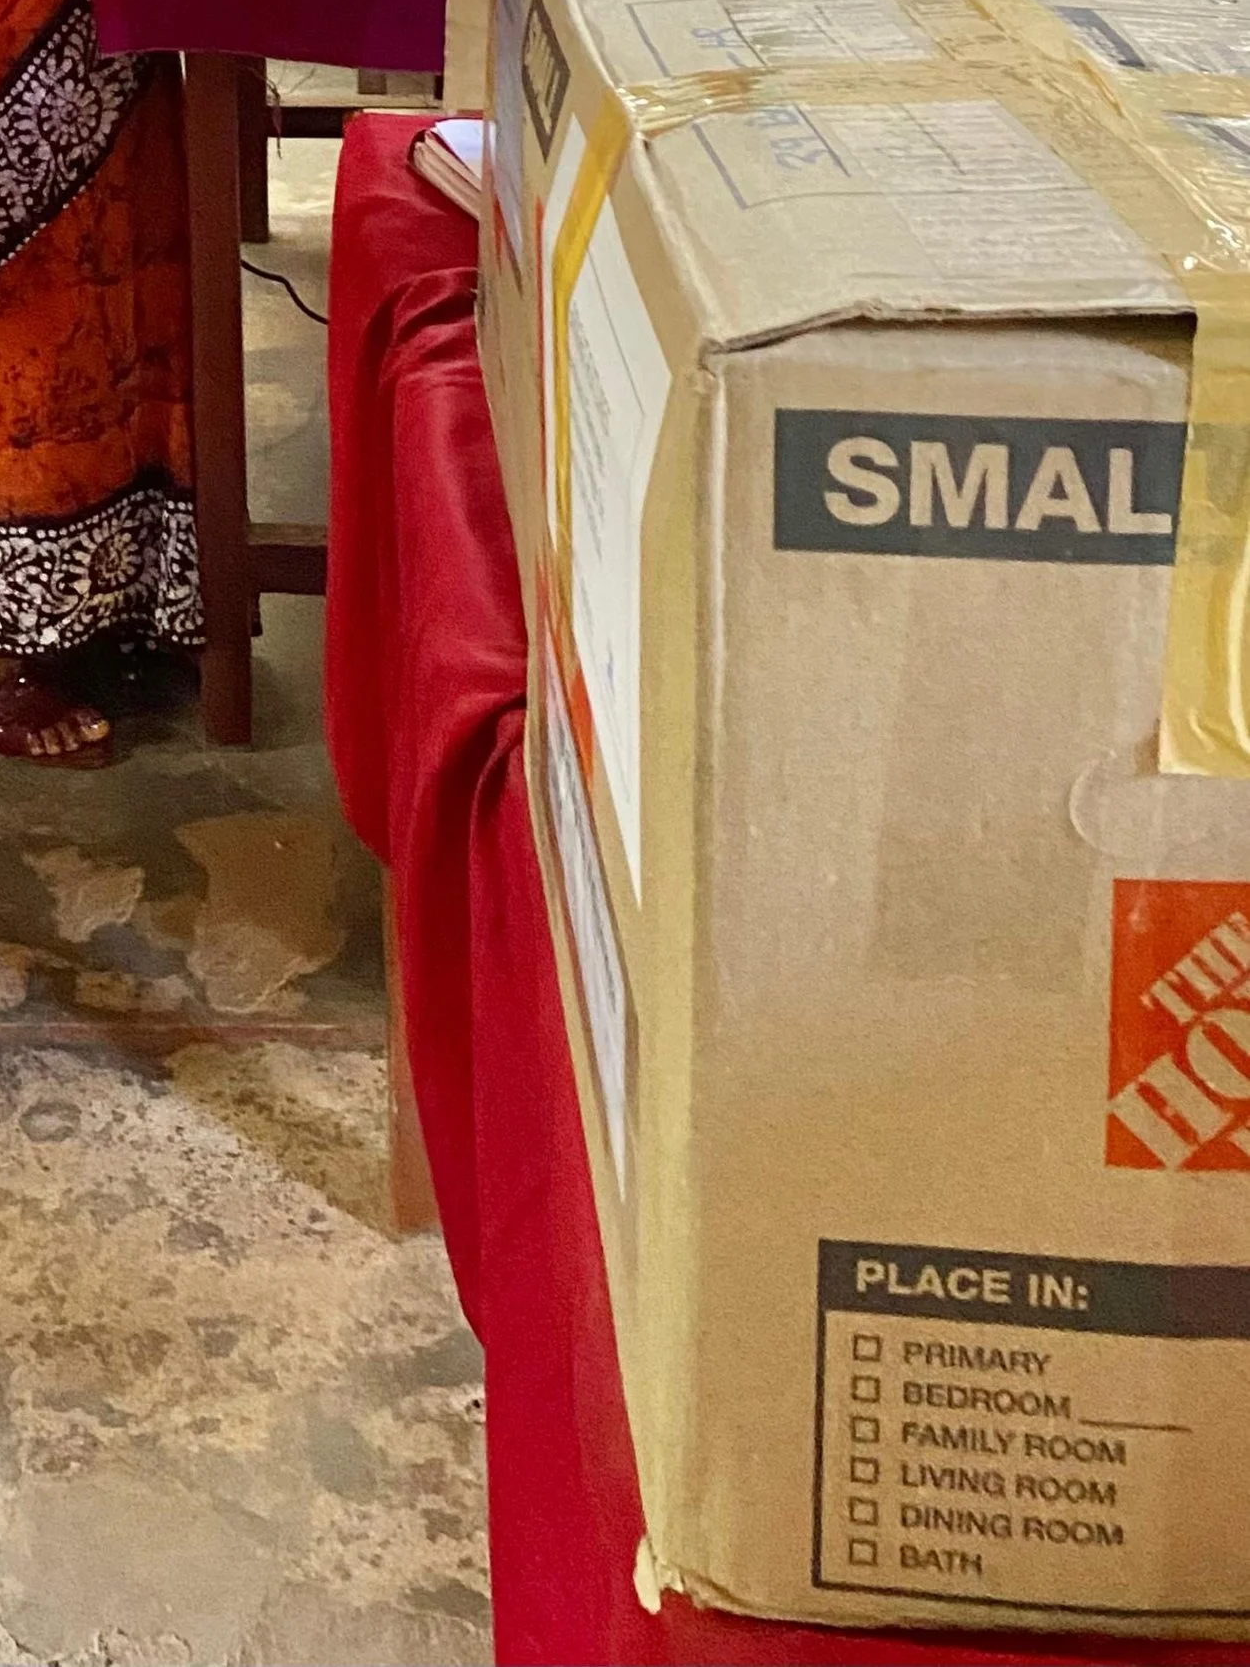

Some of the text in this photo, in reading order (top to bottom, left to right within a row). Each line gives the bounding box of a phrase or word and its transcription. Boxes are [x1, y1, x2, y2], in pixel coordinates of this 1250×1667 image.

[854, 1259, 1090, 1311] PLACE IN:
[901, 1340, 1051, 1376] PRIMARY
[902, 1380, 1072, 1421] BEDROOM
[900, 1420, 1128, 1466] FAMILY ROOM
[900, 1460, 1118, 1508] LIVING ROOM
[899, 1501, 1126, 1548] DINING ROOM
[898, 1542, 984, 1576] BATH
